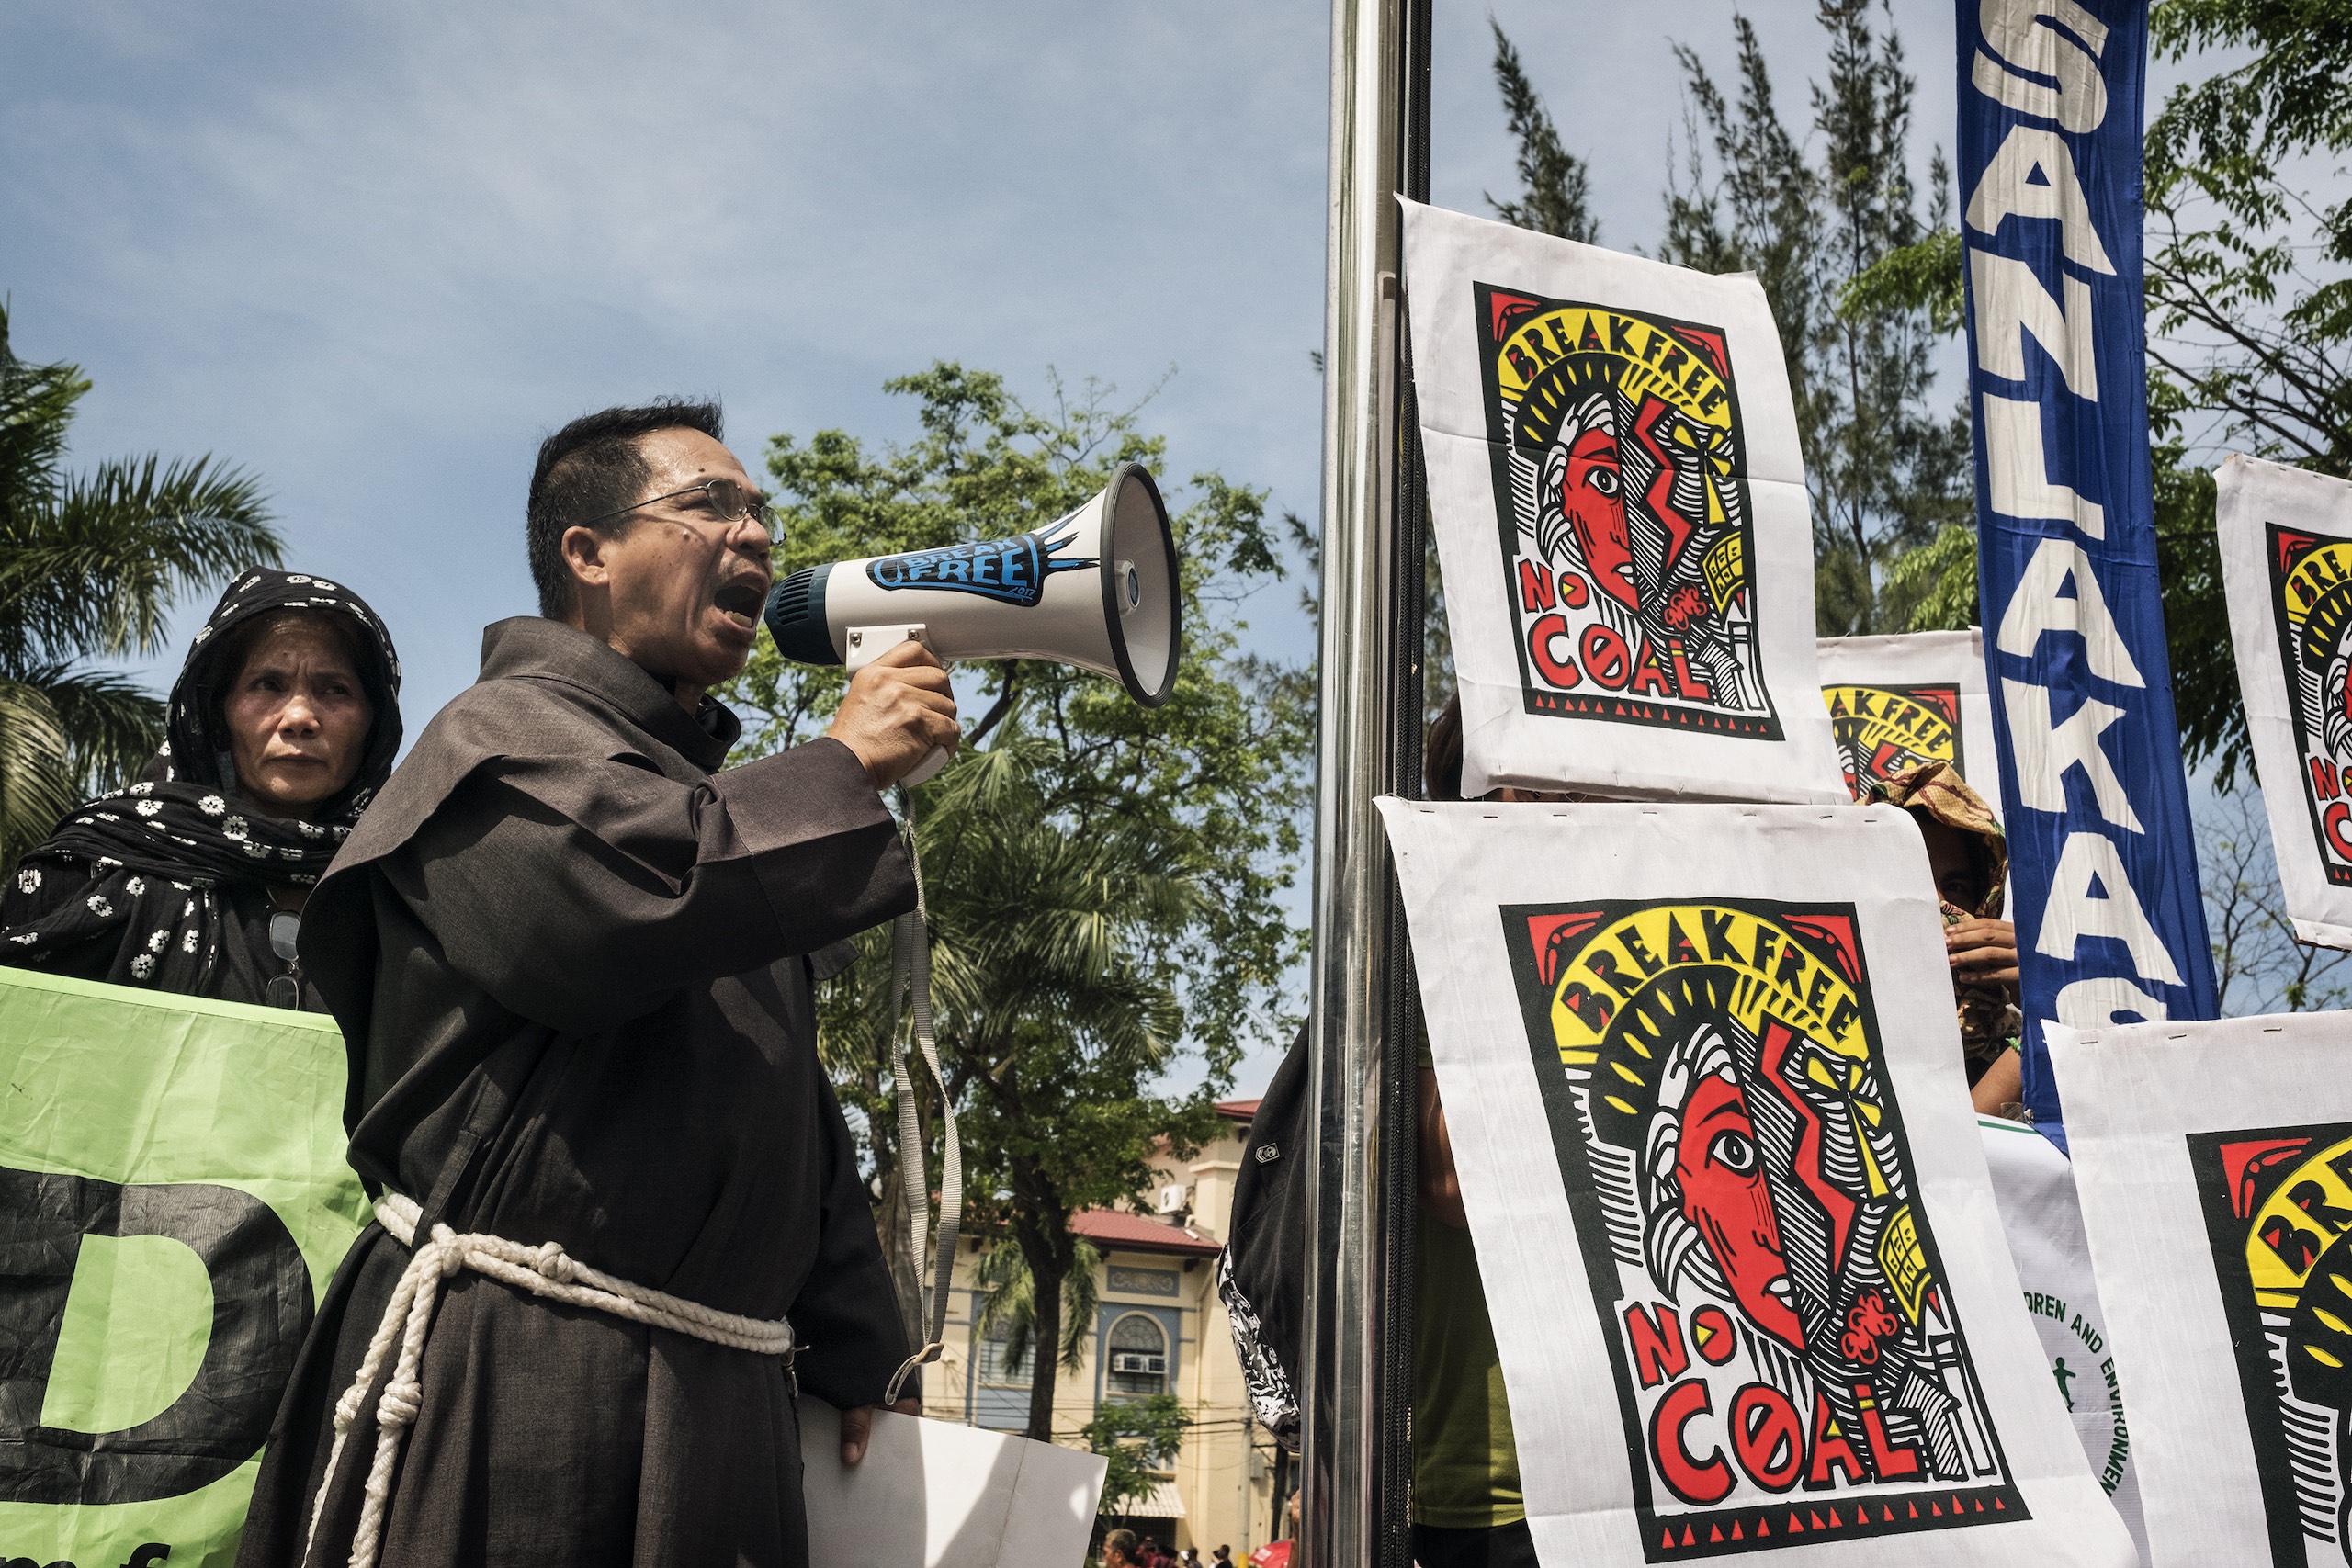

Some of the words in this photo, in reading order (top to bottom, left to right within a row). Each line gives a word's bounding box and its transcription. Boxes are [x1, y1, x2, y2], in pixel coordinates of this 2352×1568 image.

[902, 538, 1018, 568] BREAK
[909, 547, 1027, 586] FREE
[1009, 586, 1036, 596] 2017
[1519, 558, 1590, 610] NO
[1528, 614, 1714, 705] COAL
[1623, 1302, 1737, 1390] NO
[2070, 1313, 2104, 1354] AND
[1648, 1378, 1929, 1506] COAL
